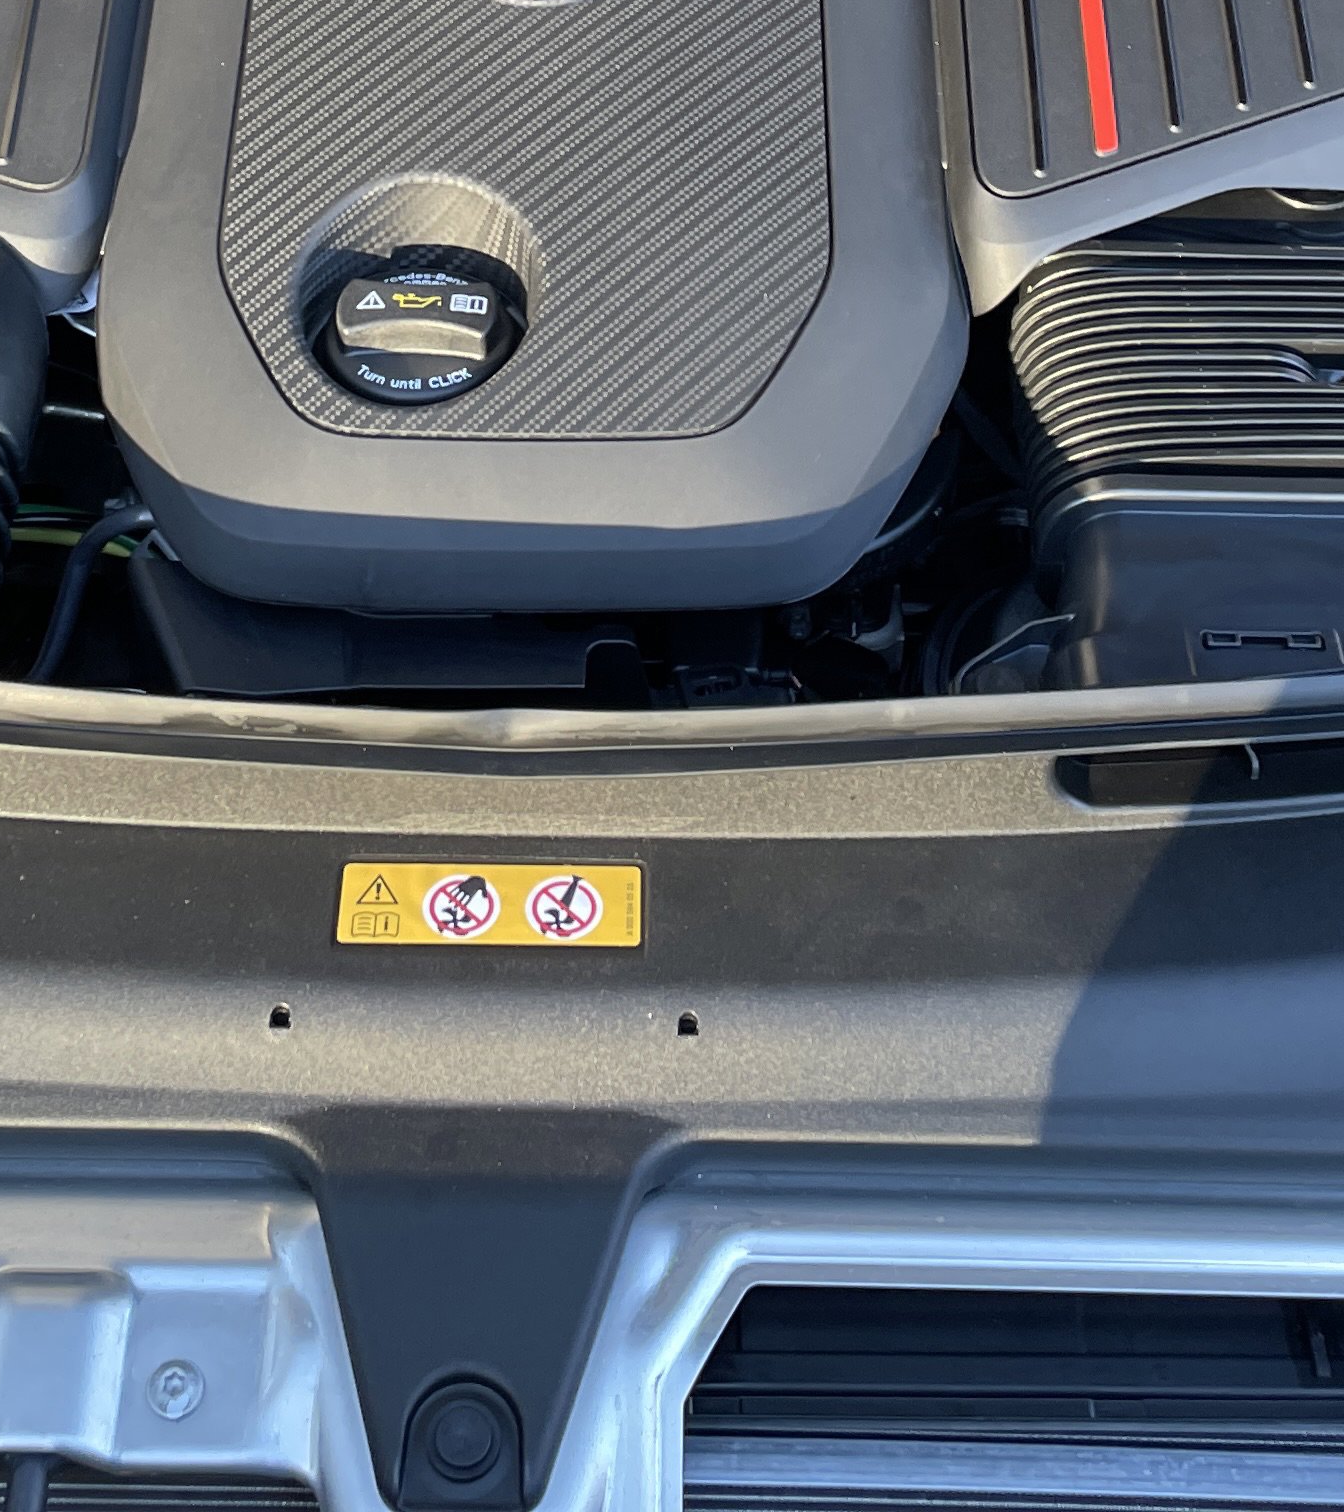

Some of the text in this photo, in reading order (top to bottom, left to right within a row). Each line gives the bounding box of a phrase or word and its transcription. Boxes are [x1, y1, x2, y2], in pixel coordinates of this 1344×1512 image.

[357, 364, 473, 390] Turn until CLICK
